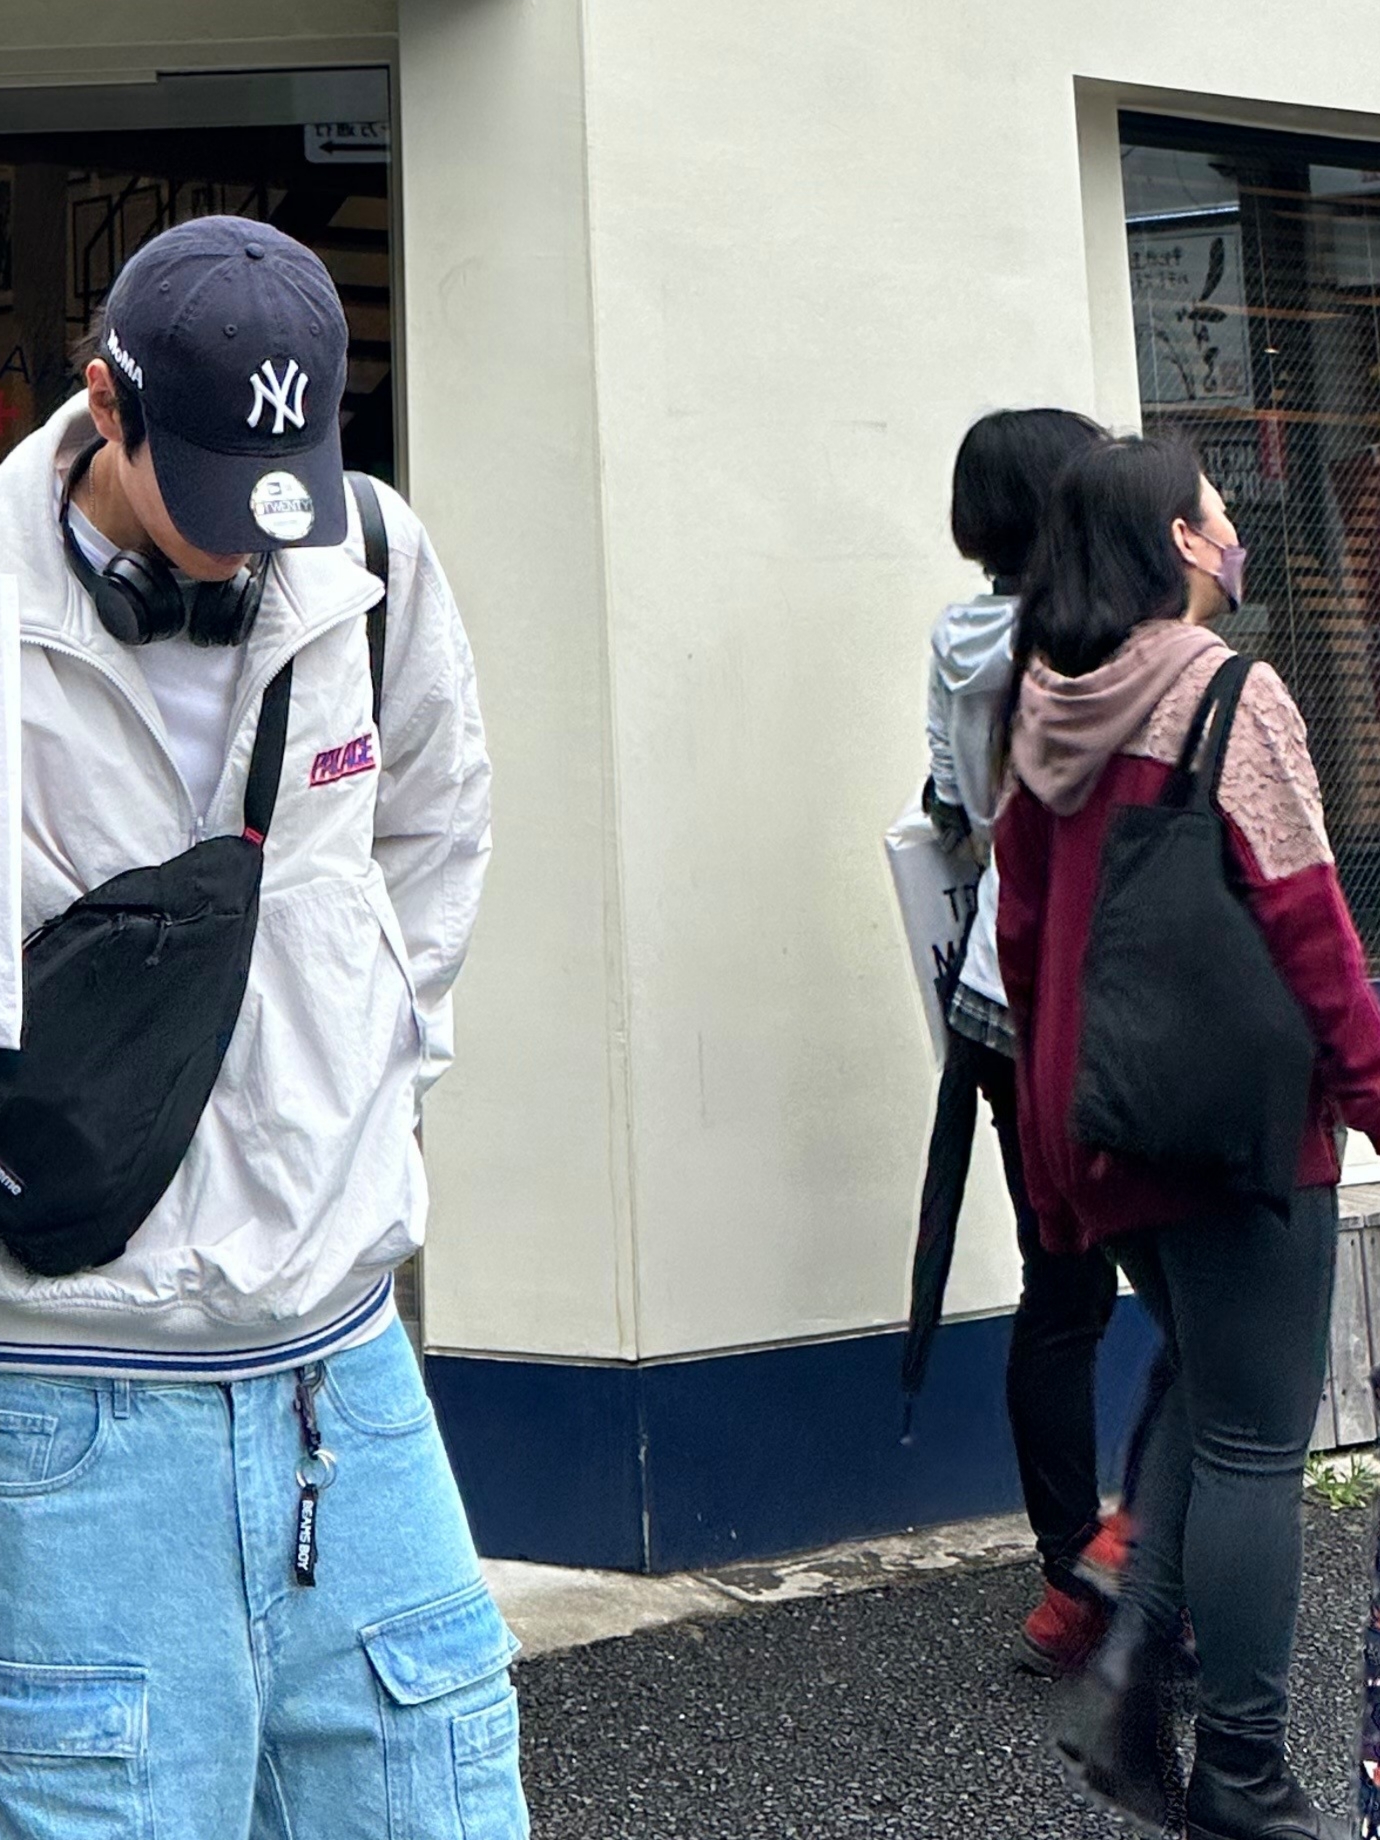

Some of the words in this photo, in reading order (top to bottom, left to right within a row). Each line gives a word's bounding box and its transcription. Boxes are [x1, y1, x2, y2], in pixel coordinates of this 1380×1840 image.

[107, 328, 144, 390] MoMA
[246, 359, 309, 434] NY
[310, 733, 374, 785] PALACE
[299, 1499, 314, 1543] BEAMS
[297, 1544, 311, 1571] BOY
